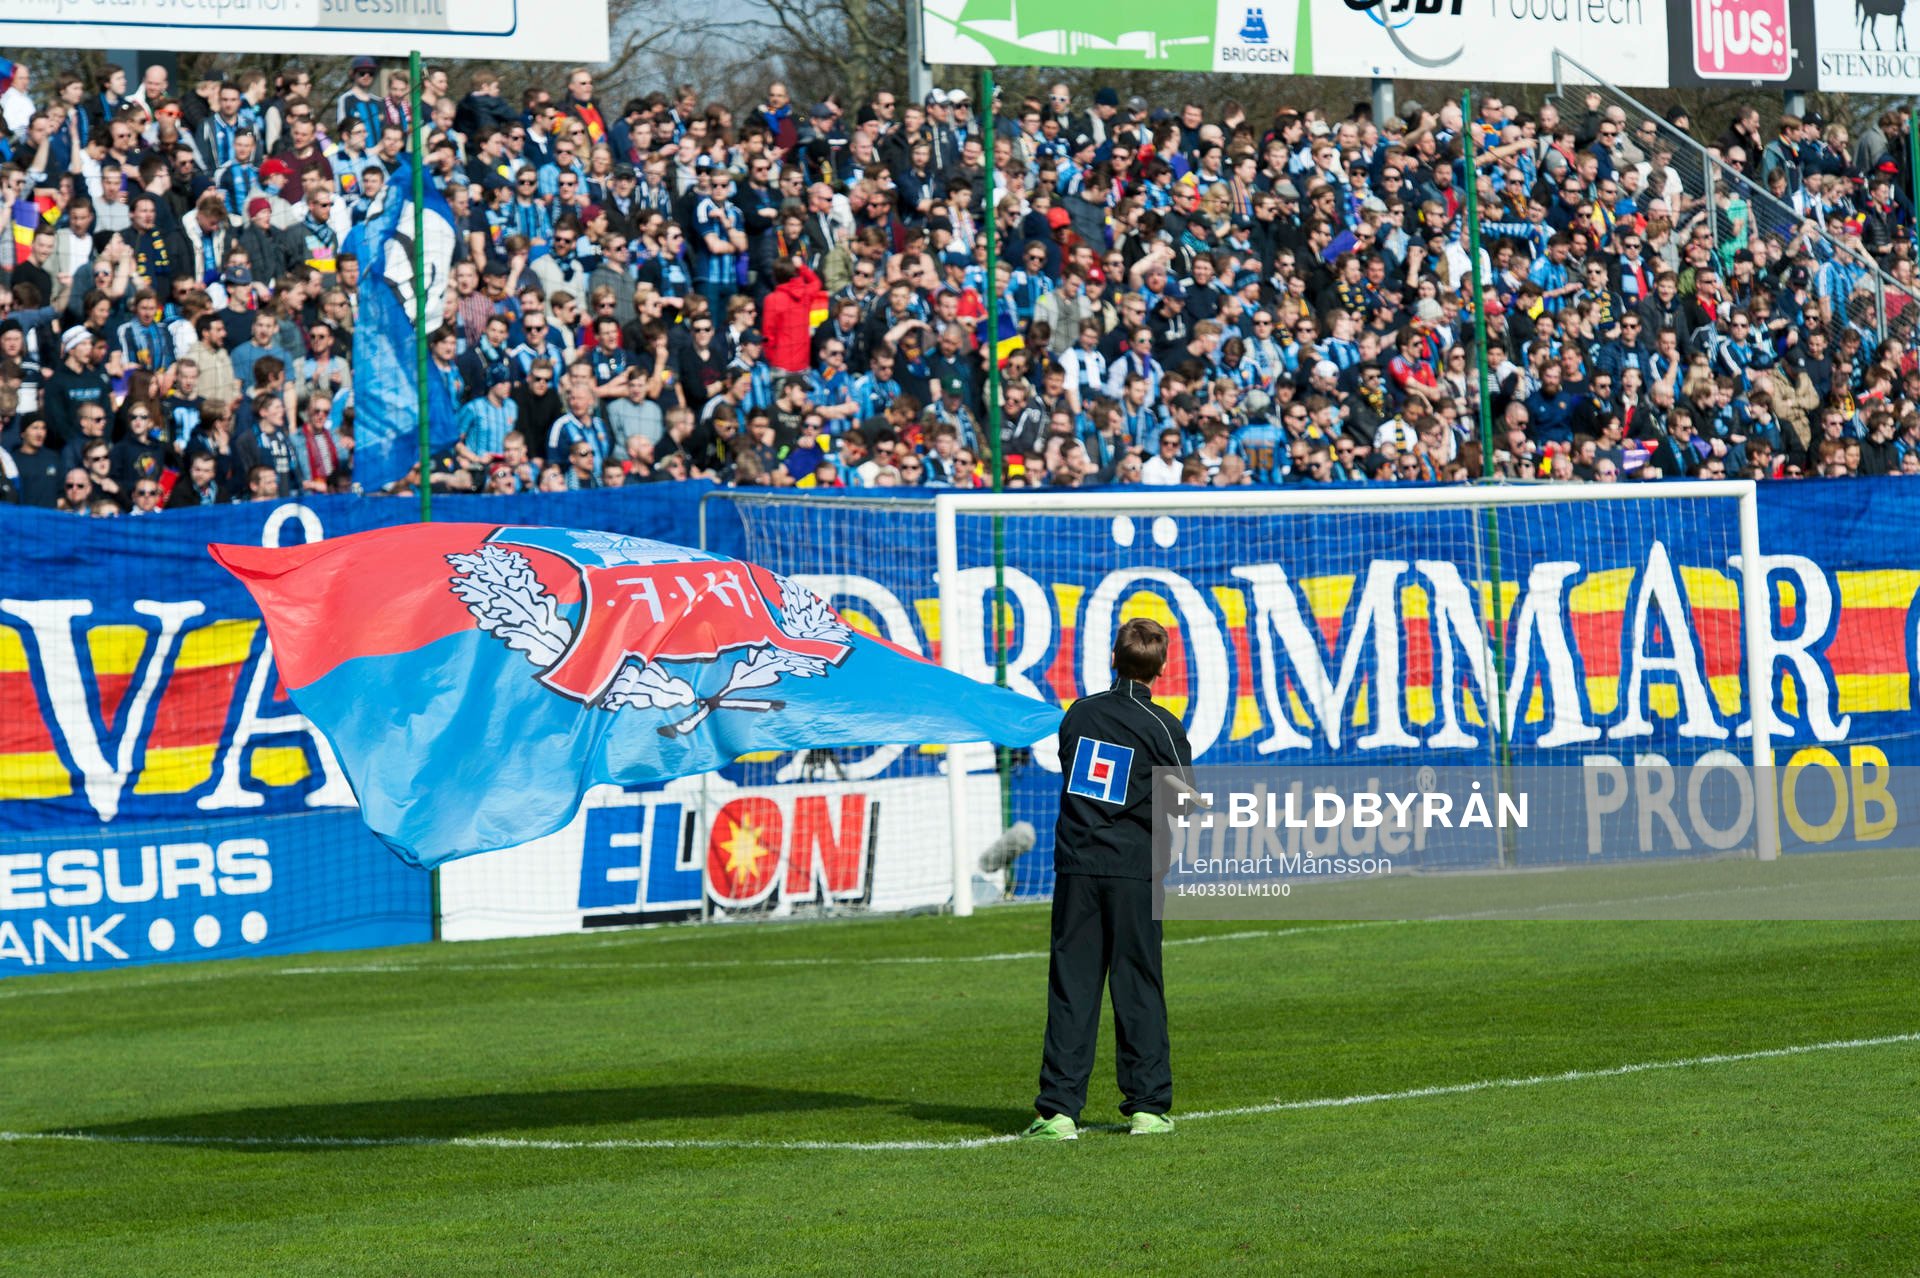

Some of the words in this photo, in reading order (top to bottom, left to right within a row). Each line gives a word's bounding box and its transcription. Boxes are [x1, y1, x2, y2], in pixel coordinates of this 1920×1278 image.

[1222, 47, 1289, 62] BRIGGEN
[1821, 52, 1920, 78] STENBOC
[1583, 744, 1898, 857] PROOB
[578, 793, 868, 909] ELON
